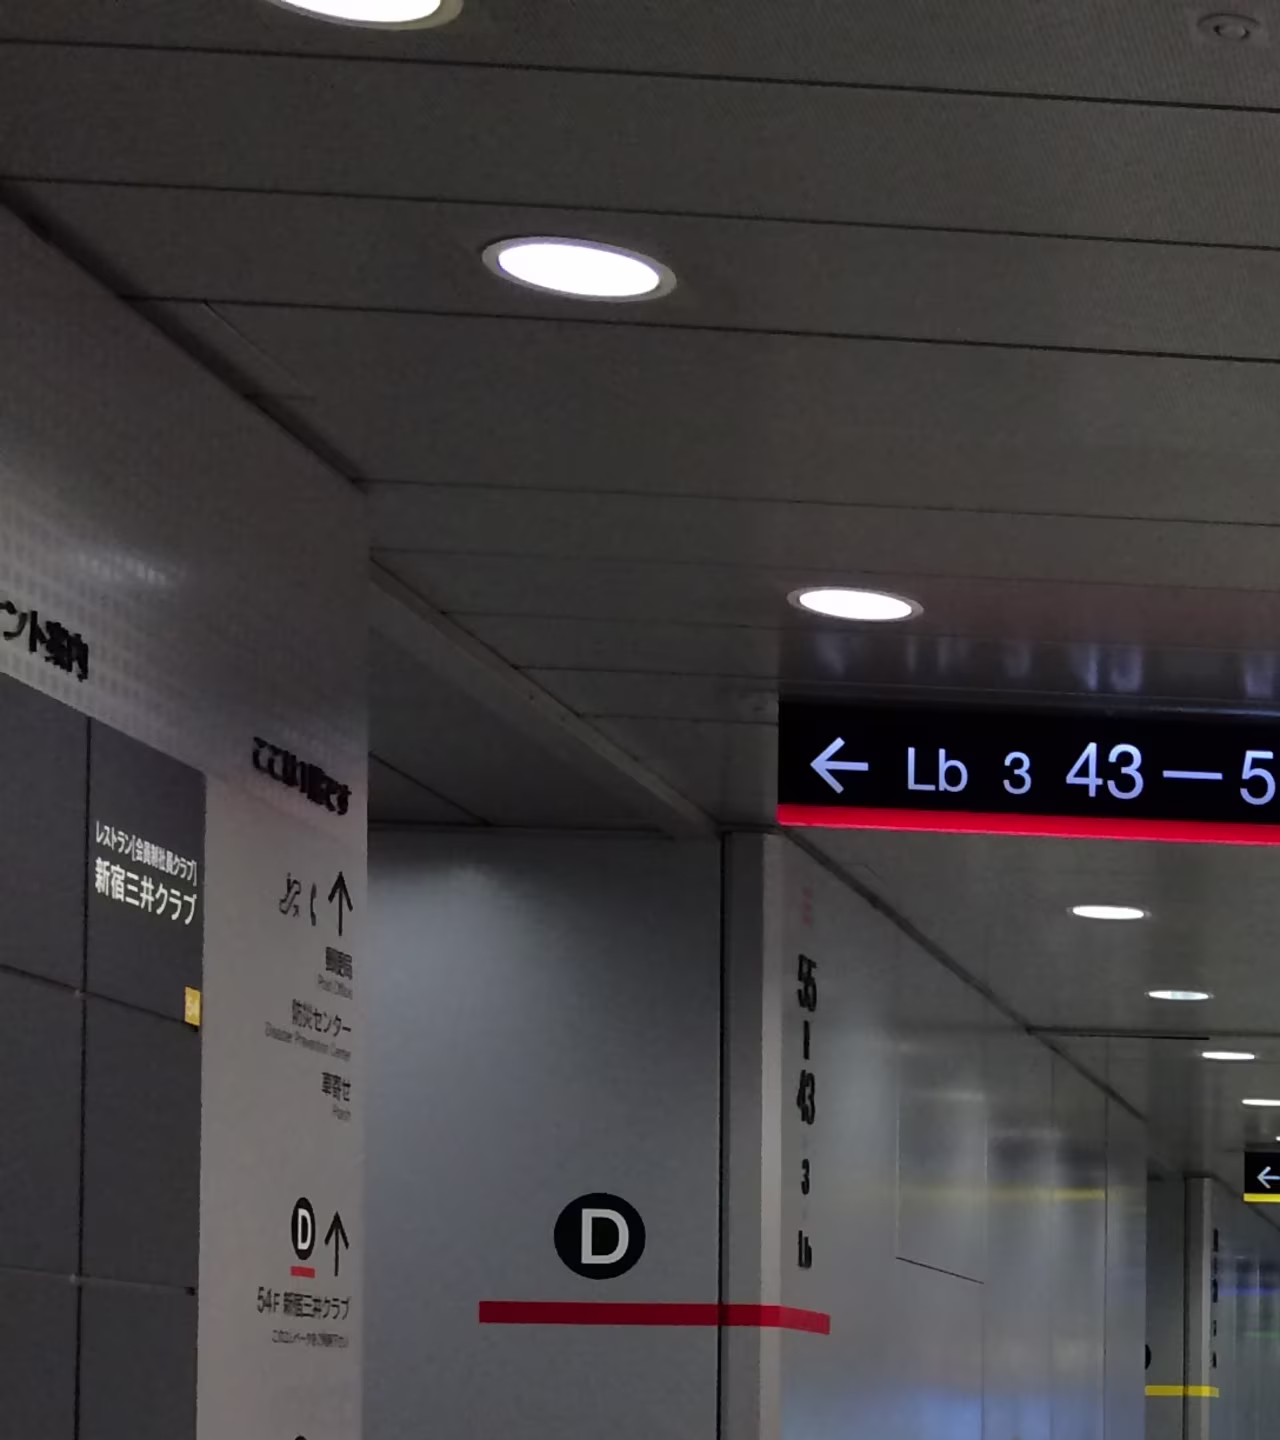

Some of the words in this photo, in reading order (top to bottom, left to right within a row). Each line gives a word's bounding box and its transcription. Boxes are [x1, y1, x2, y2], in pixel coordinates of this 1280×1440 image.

[907, 747, 968, 792] Lb
[1003, 752, 1032, 795] 3
[94, 857, 198, 925] 新宿三井クラブ
[581, 1207, 630, 1265] D
